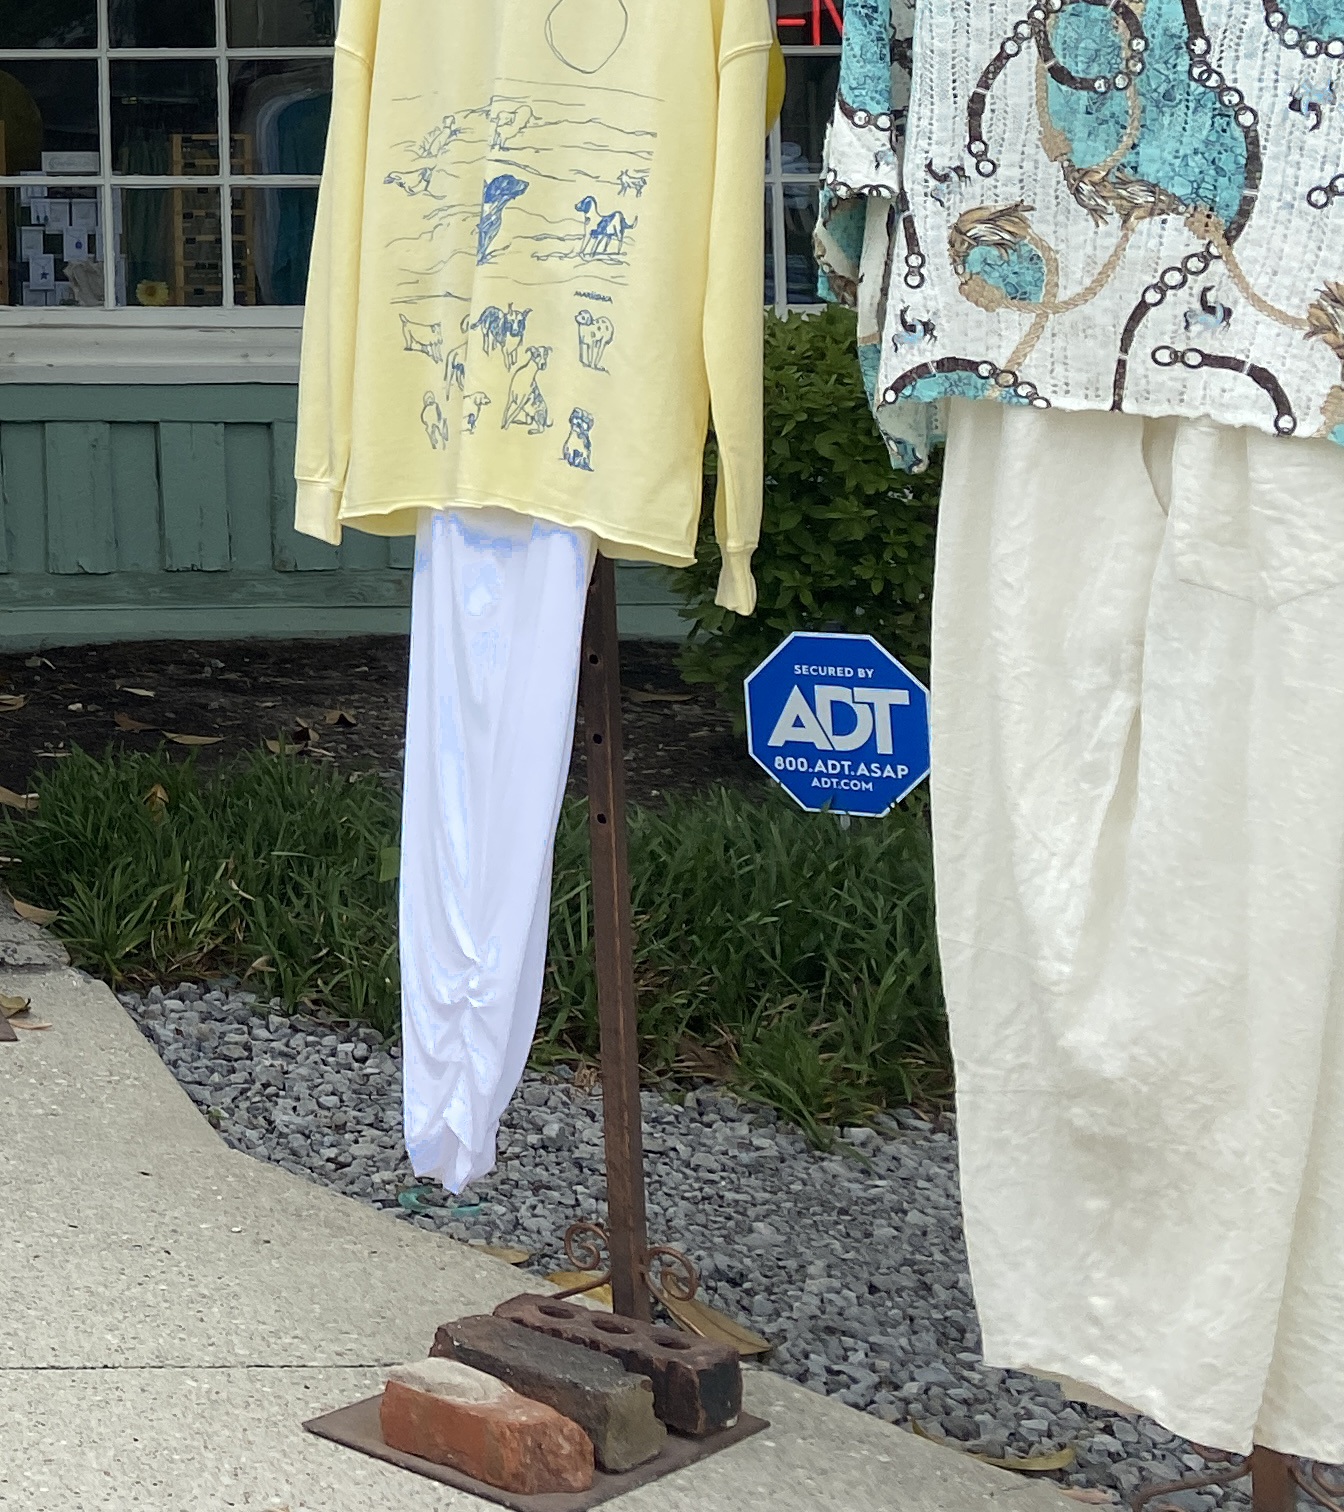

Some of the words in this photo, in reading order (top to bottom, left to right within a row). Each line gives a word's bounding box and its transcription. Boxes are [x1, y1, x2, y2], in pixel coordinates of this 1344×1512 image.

[793, 664, 854, 678] SECURED
[857, 667, 874, 679] BY
[767, 684, 910, 755] ADT
[774, 755, 909, 779] 800.ADT.ASAP
[811, 777, 873, 792] ADT.COM
